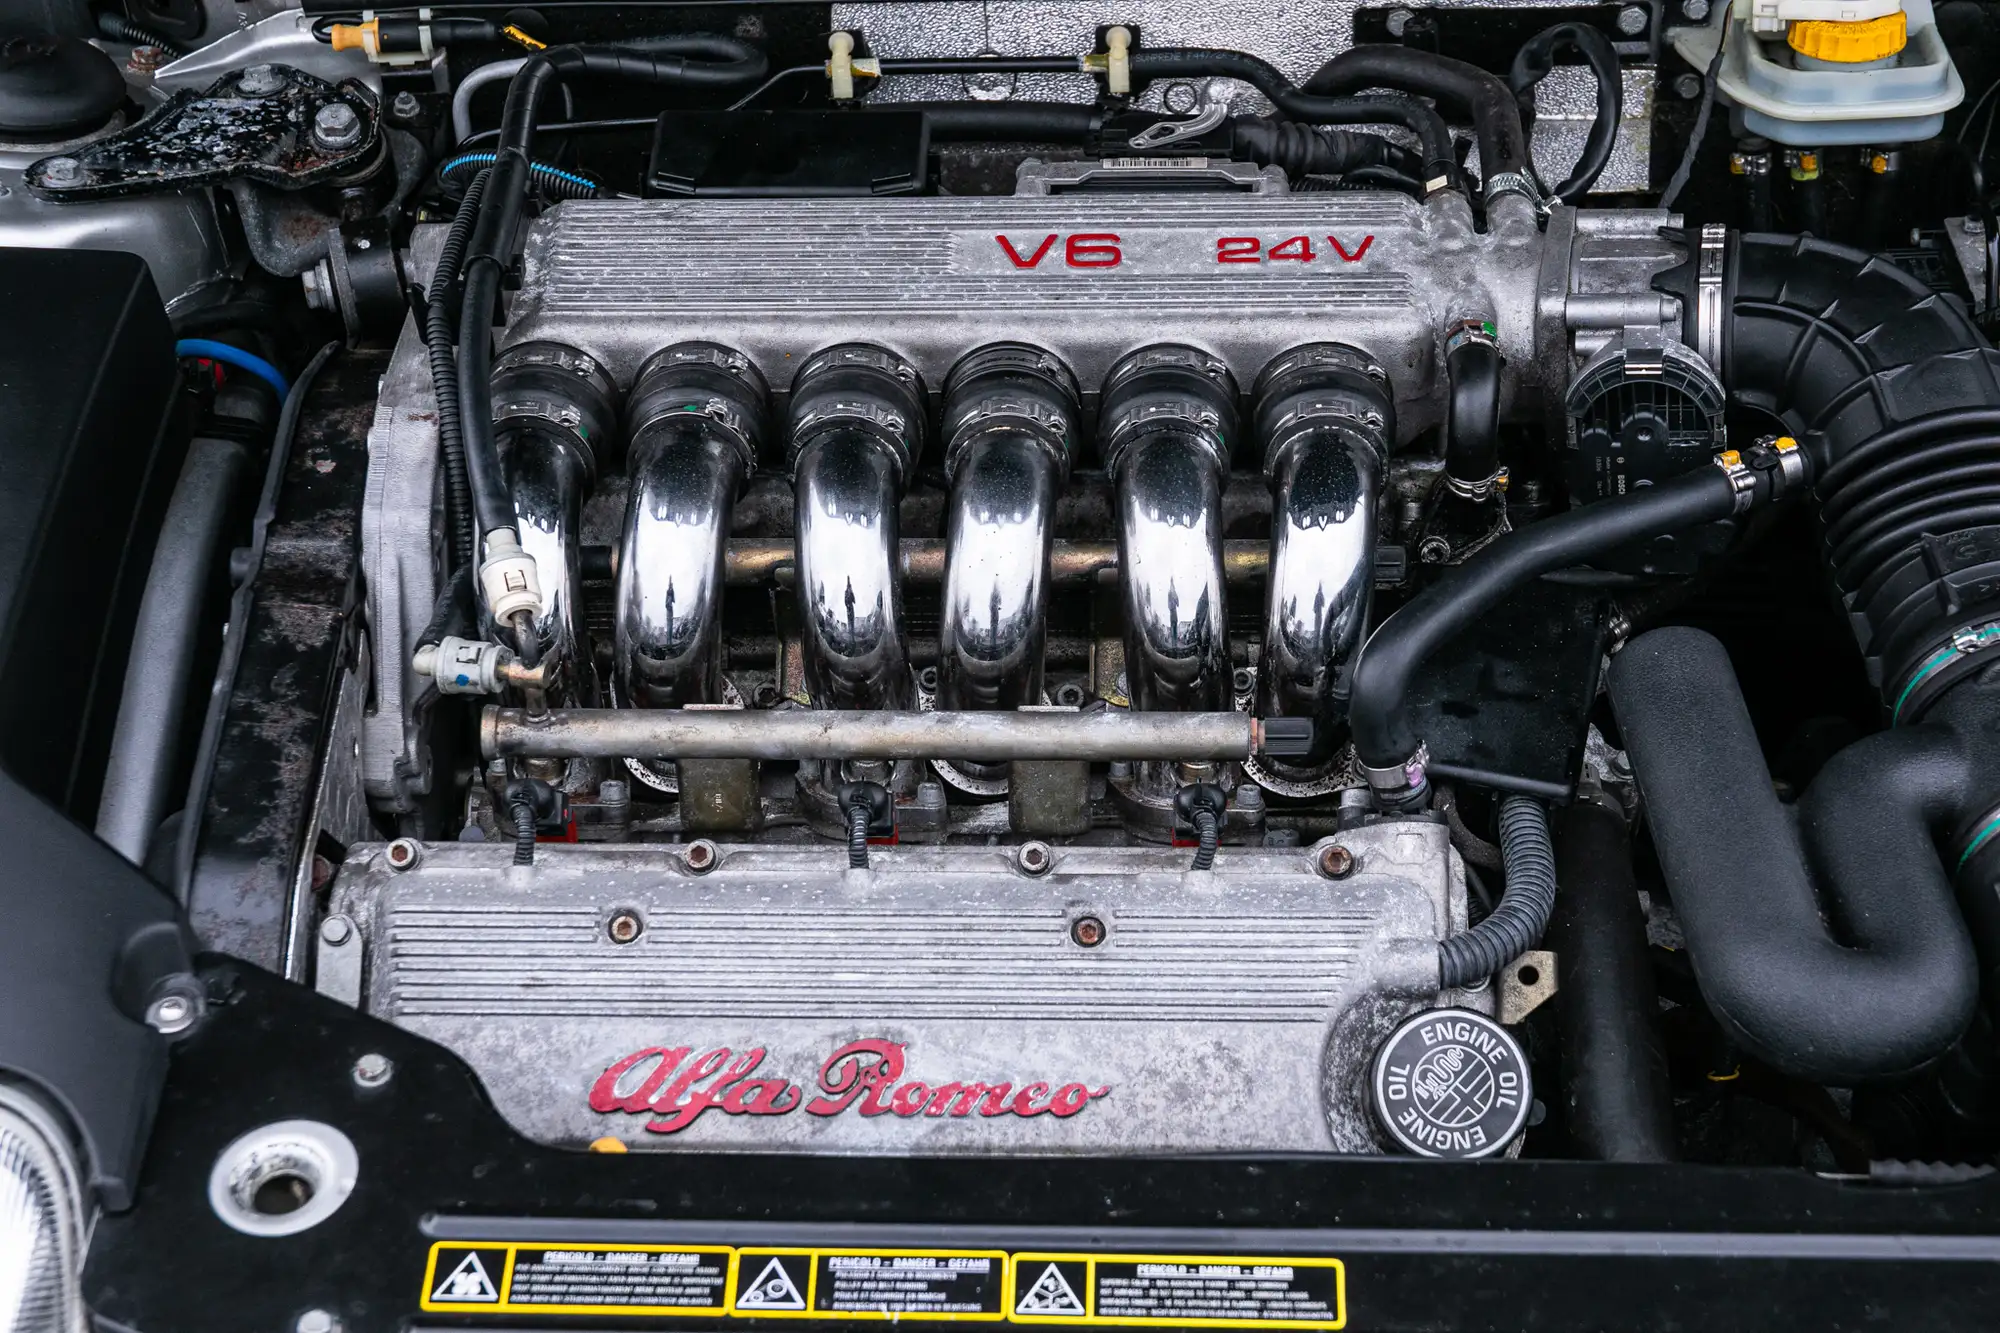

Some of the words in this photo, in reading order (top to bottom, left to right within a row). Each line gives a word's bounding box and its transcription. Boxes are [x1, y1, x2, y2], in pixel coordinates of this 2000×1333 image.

[995, 233, 1122, 269] V6
[1216, 235, 1375, 264] 24V
[588, 1046, 802, 1134] Alfa
[805, 1037, 1113, 1118] Romeo
[1388, 1063, 1411, 1100] OIL
[1420, 1021, 1508, 1065] ENGINE
[1496, 1071, 1518, 1108] OIL
[1398, 1106, 1487, 1150] ENGINE
